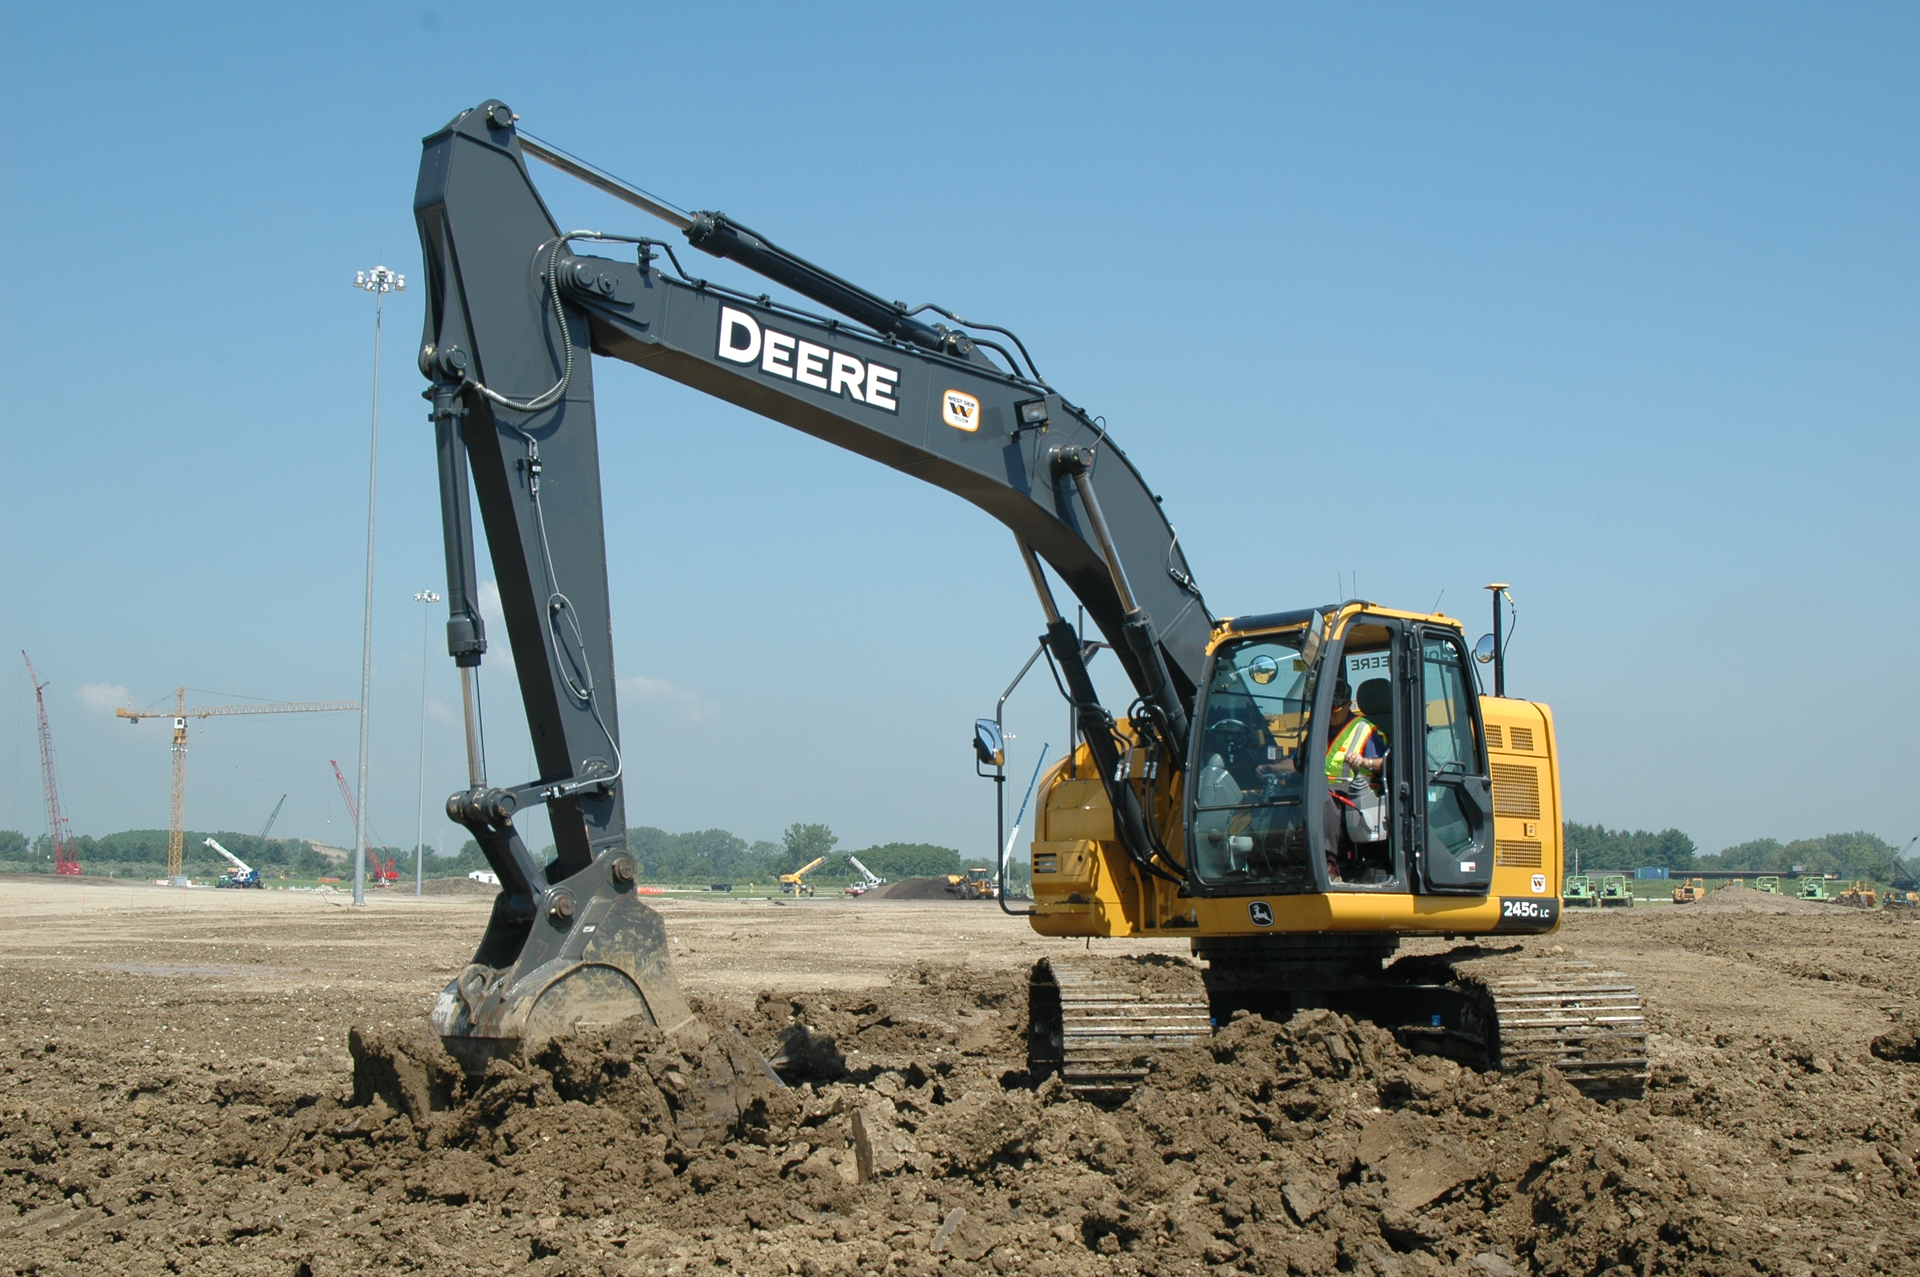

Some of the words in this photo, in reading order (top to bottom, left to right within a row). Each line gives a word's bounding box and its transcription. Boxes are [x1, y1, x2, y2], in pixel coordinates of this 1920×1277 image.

[718, 306, 898, 411] DEERE
[1503, 901, 1538, 917] 245G
[1540, 909, 1550, 918] LC
